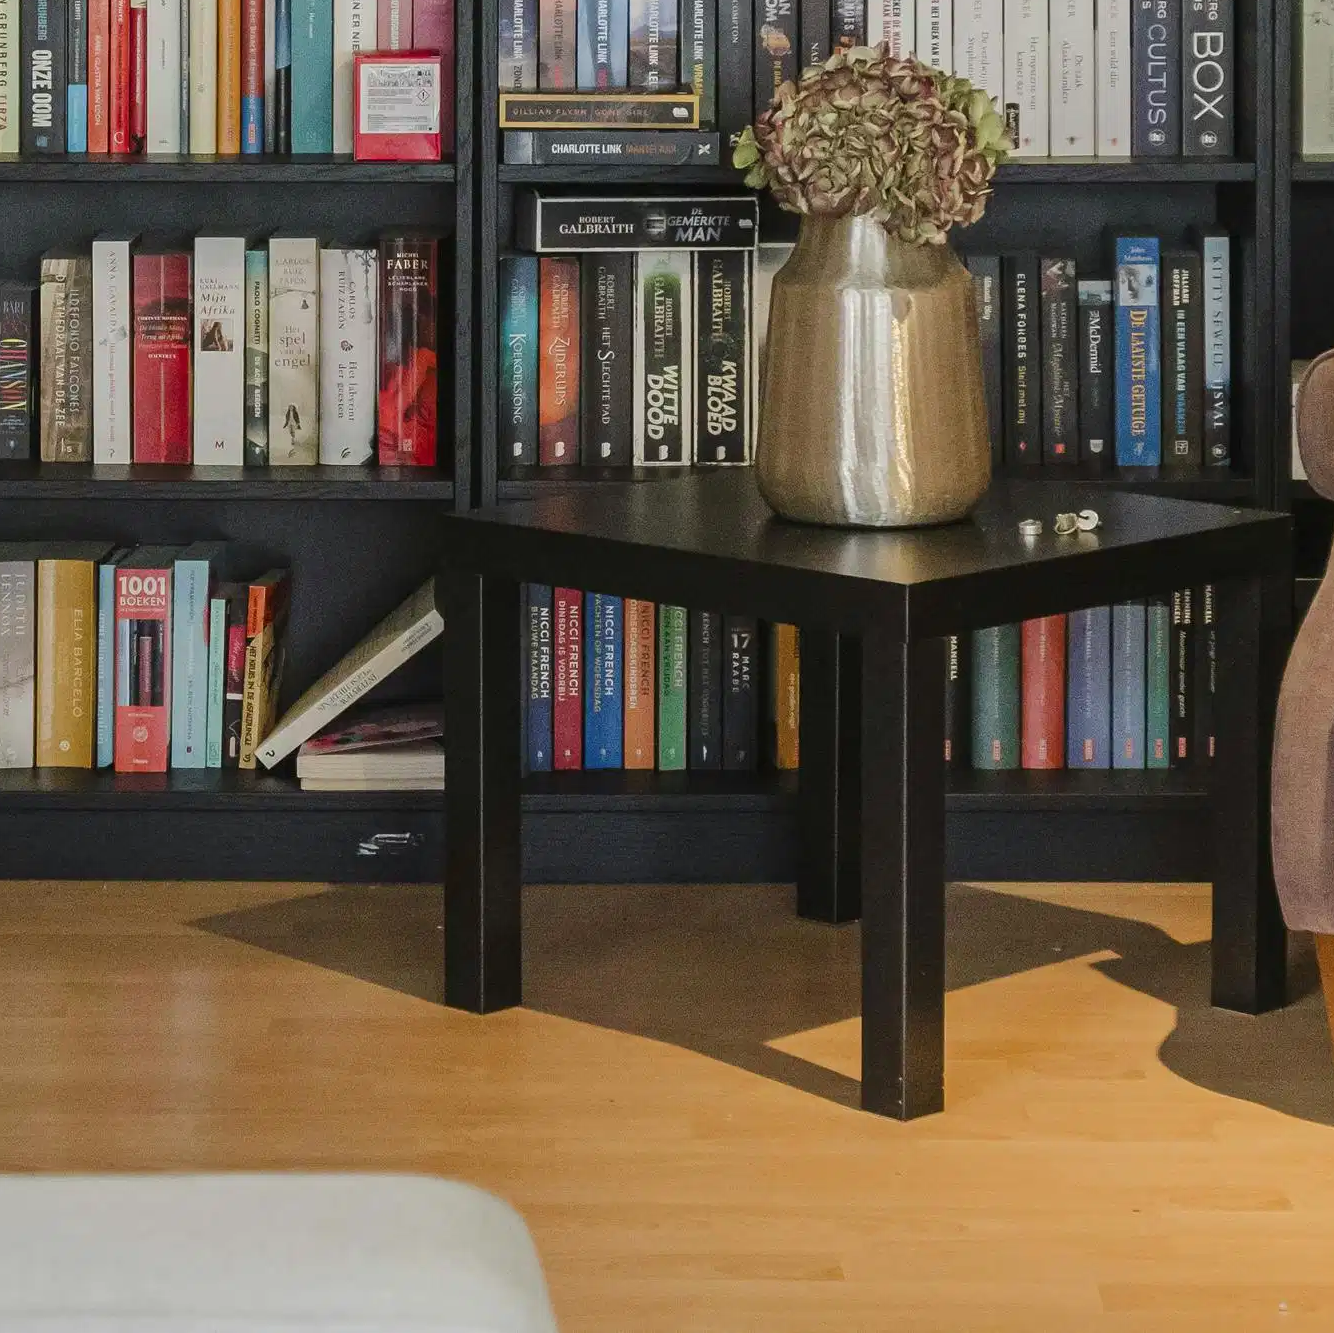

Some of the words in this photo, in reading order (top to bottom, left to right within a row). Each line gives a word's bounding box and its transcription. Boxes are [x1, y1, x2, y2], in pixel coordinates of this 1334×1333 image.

[352, 14, 360, 28] ER
[0, 14, 7, 87] GRUNBERG
[32, 49, 52, 88] ONZE
[694, 41, 703, 60] LINK
[1148, 24, 1166, 124] CULTUS
[1193, 31, 1224, 120] BOX
[32, 93, 52, 127] OOM
[551, 144, 600, 153] CHARLOTTE
[602, 144, 622, 153] LINK
[559, 224, 635, 234] GALBRAITH
[667, 215, 731, 226] GEMERKTE
[675, 227, 722, 242] MAN
[386, 259, 428, 269] FABER
[1017, 273, 1026, 309] ELENA
[70, 289, 80, 351] ILDEFONSO
[602, 327, 610, 346] HET
[1017, 313, 1027, 358] FORBES
[1130, 310, 1147, 328] DE
[1089, 317, 1101, 373] McDermid
[1131, 332, 1145, 381] LAATSTE
[0, 338, 27, 410] CHANSON
[70, 357, 80, 412] FALCONES
[664, 365, 678, 425] WITTE
[602, 403, 610, 424] PAD
[647, 374, 664, 440] DOOD
[708, 375, 722, 435] BLOED
[721, 360, 736, 431] KWAAD
[1131, 385, 1145, 436] GETUIGE
[119, 576, 166, 595] 1001
[120, 596, 166, 605] BOEKEN
[540, 607, 550, 642] NICCI
[558, 601, 566, 644] DINSDAG
[569, 605, 578, 640] NICCI
[540, 646, 550, 698] FRENCH
[558, 647, 566, 655] IS
[569, 645, 578, 696] FRENCH
[950, 636, 958, 680] MANKELL
[558, 659, 566, 701] VOORBIJ
